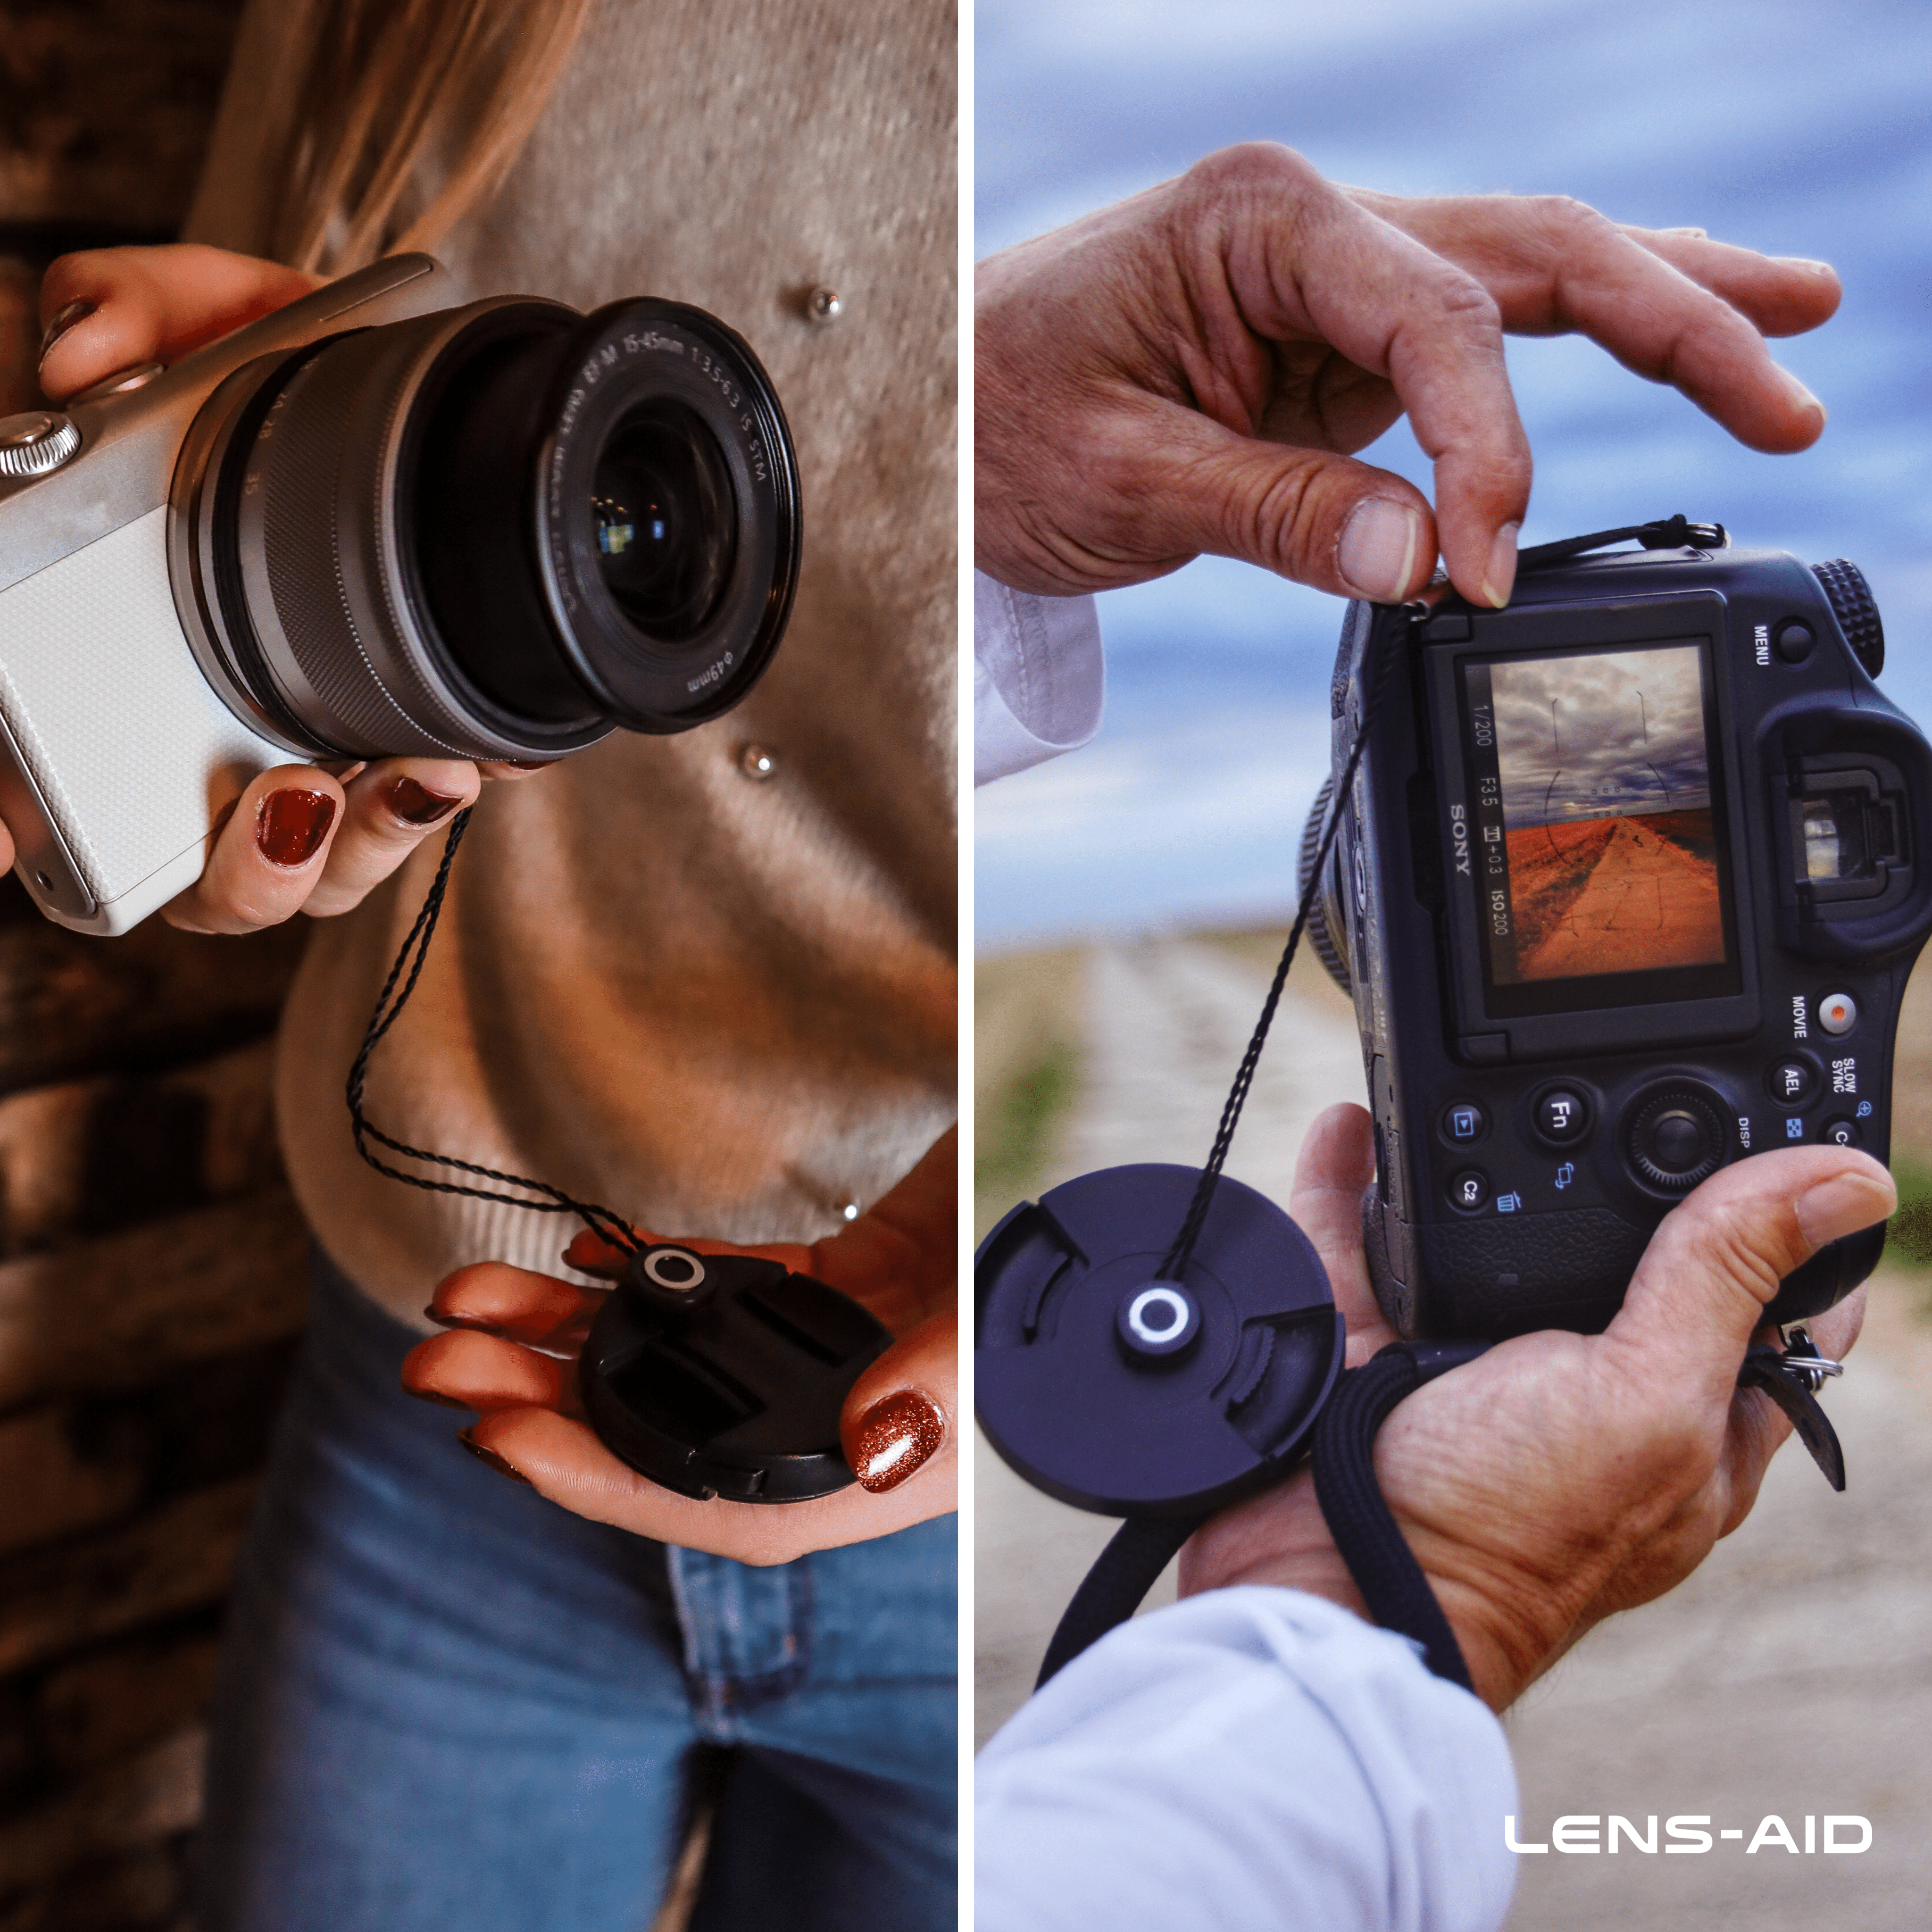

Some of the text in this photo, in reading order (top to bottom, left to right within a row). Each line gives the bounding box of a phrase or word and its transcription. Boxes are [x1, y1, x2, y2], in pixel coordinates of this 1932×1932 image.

[740, 413, 753, 432] IS
[749, 439, 766, 481] STM
[1755, 626, 1769, 665] MENU
[1474, 705, 1492, 746] 1/200
[1481, 777, 1498, 806] F3.5
[1450, 804, 1470, 876] SONY
[1792, 996, 1807, 1039] MOVIE
[1785, 1069, 1799, 1095] AEL
[1832, 1060, 1845, 1093] SYNC
[1843, 1058, 1856, 1093] SLOW
[1551, 1102, 1570, 1128] Fn
[1738, 1117, 1750, 1148] DISP
[1835, 1132, 1848, 1146] C
[1464, 1181, 1477, 1200] C2
